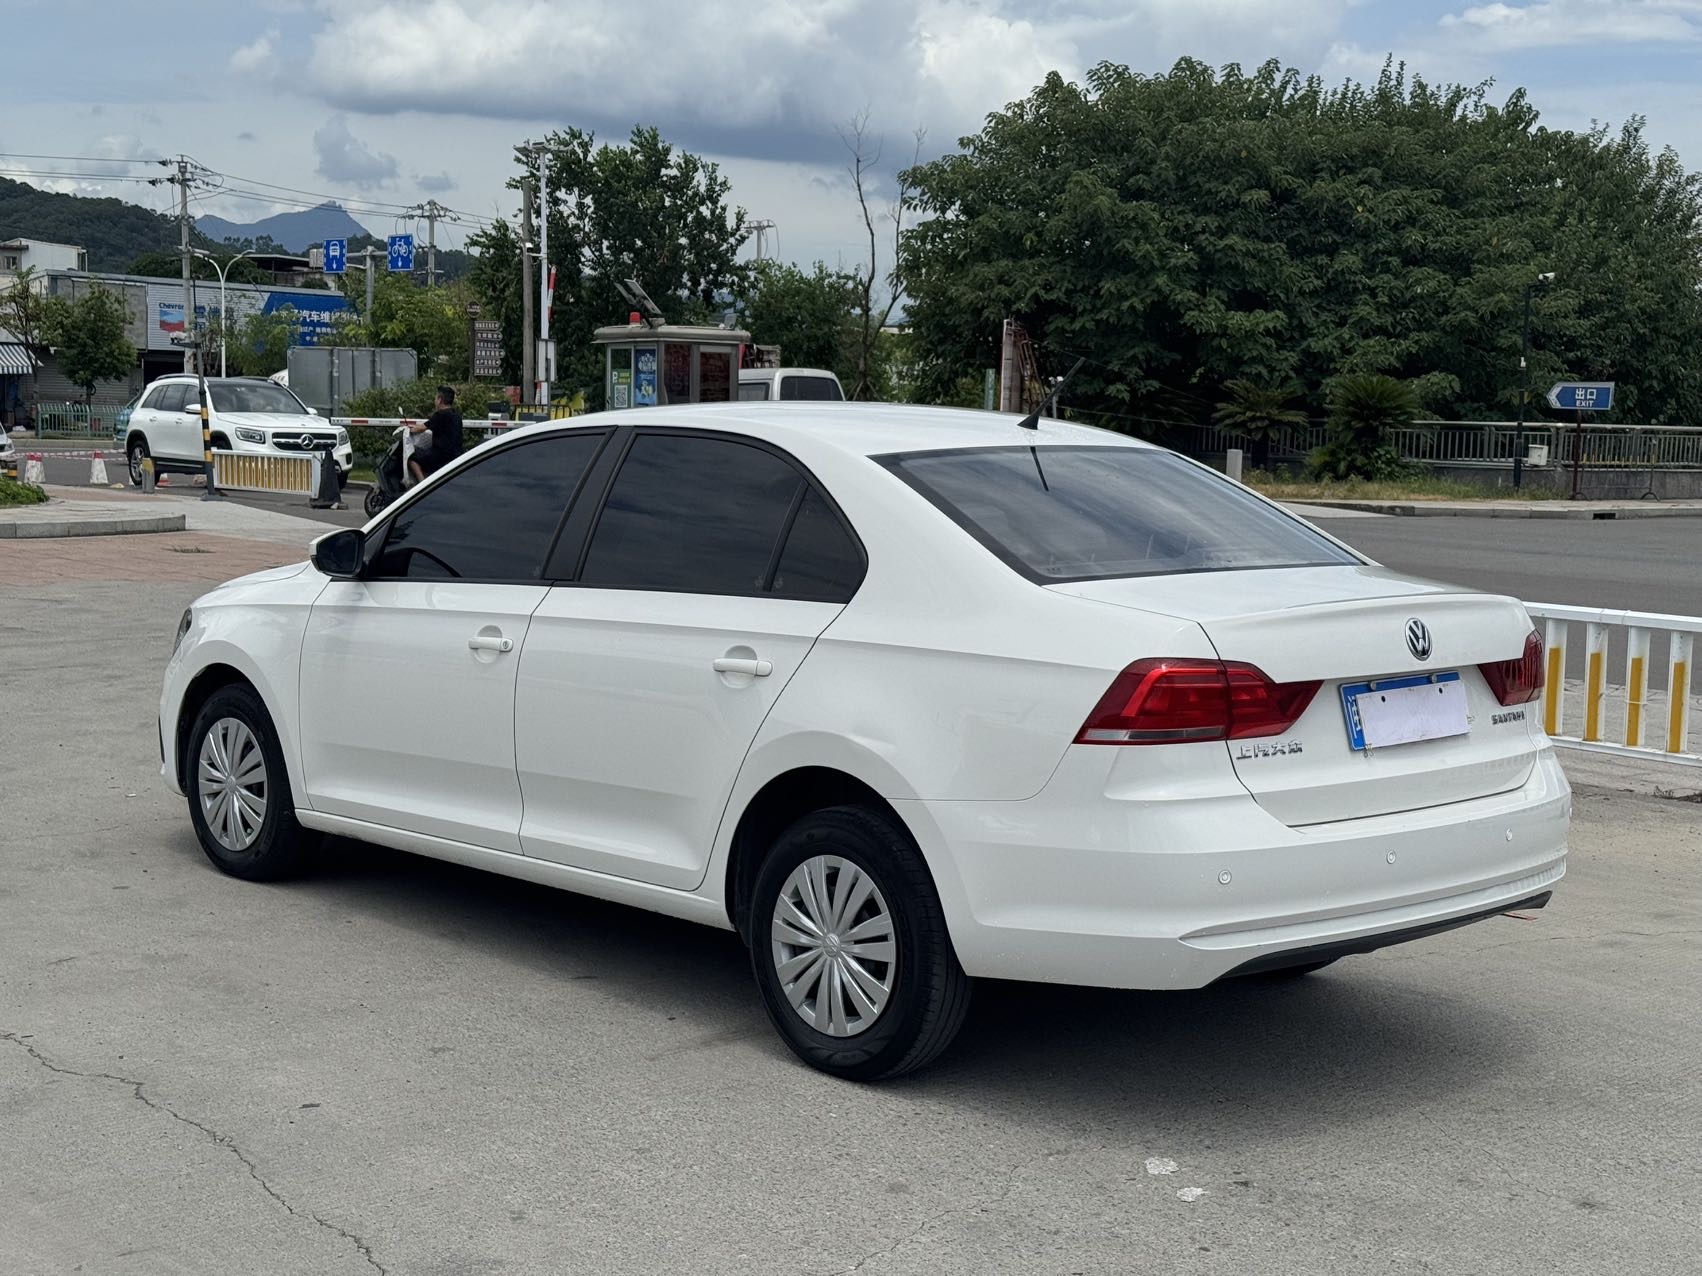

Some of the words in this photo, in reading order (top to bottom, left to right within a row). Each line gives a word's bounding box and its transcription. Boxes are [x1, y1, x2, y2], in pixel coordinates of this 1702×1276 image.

[1575, 387, 1597, 400] 出口
[1236, 740, 1303, 760] 上汽大众
